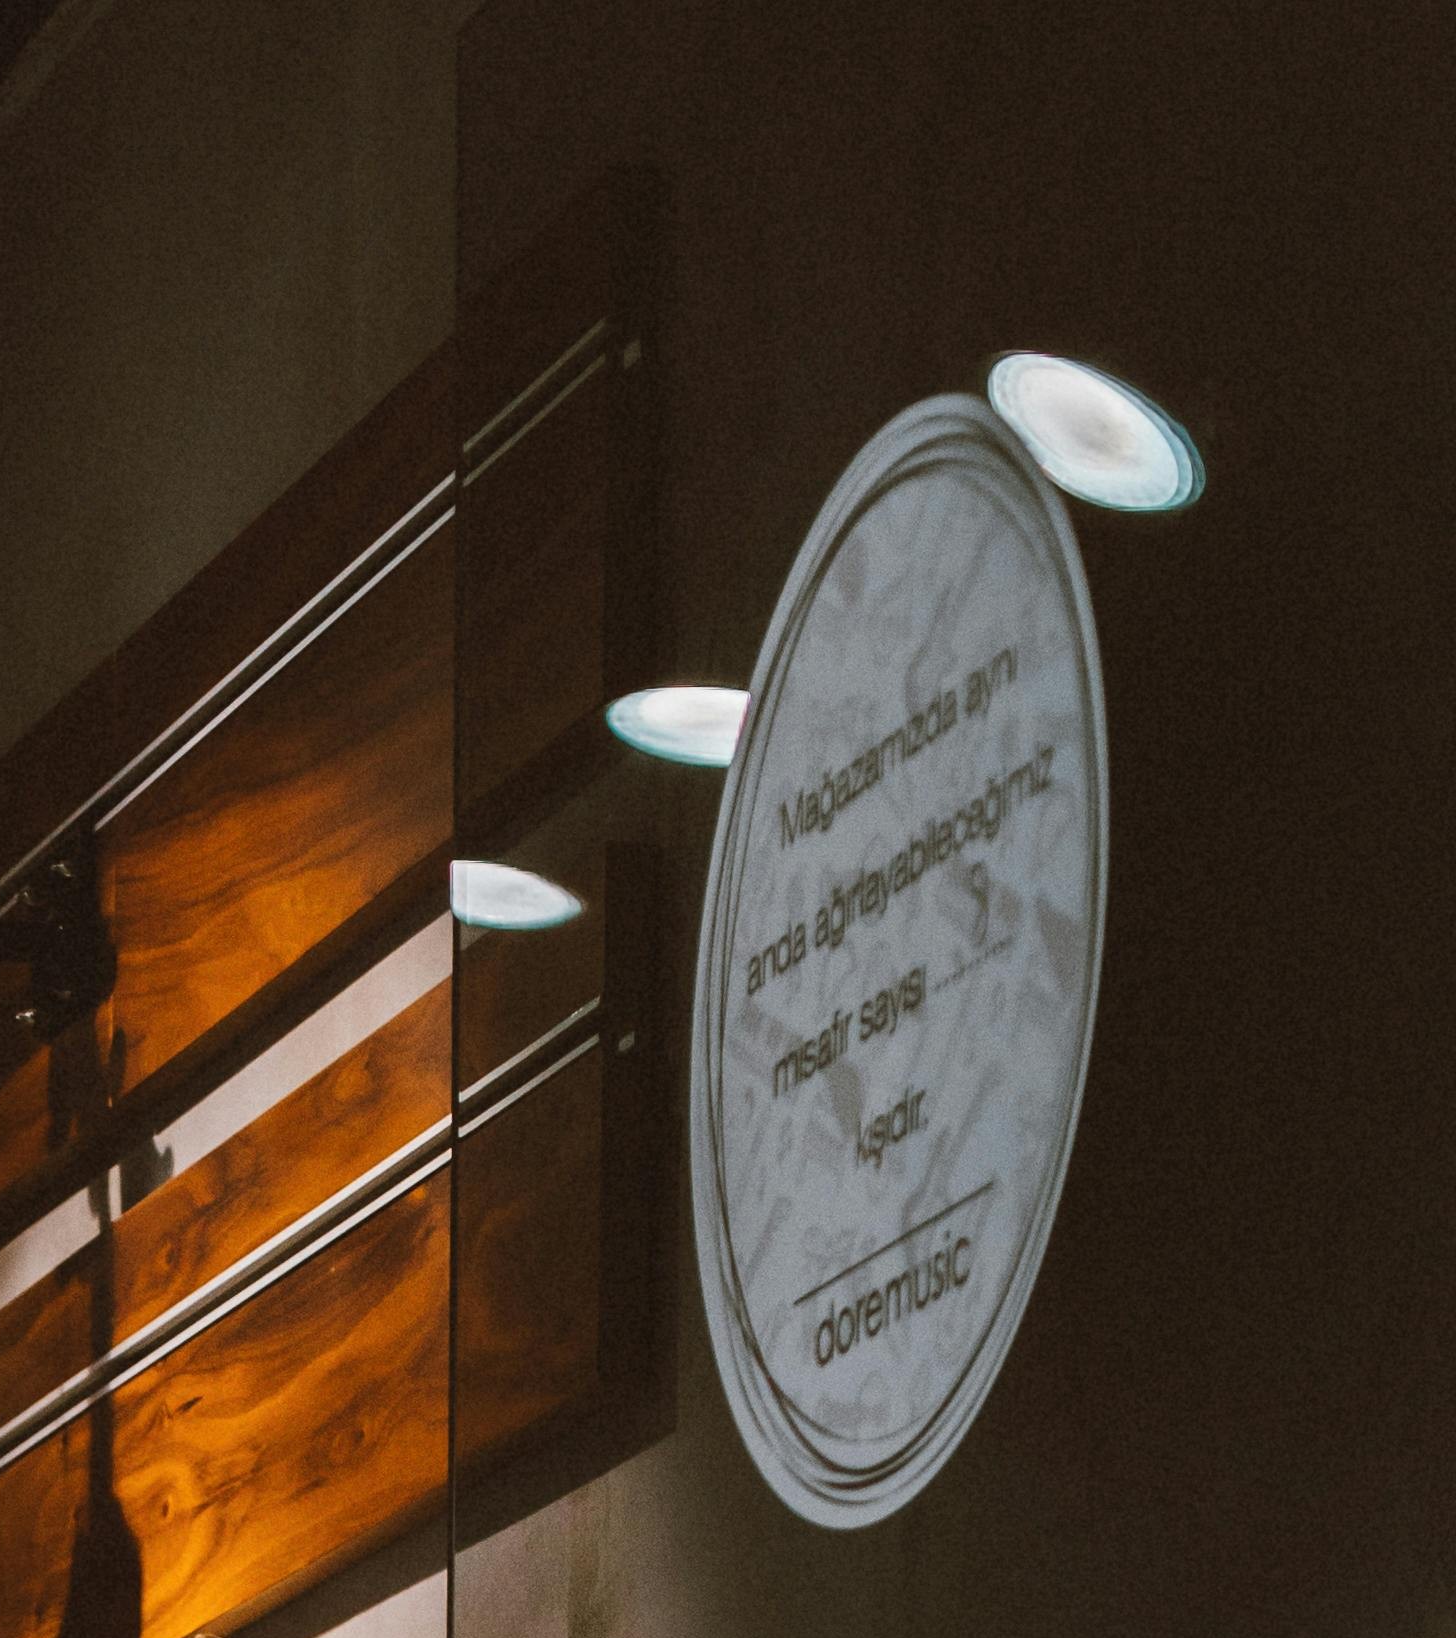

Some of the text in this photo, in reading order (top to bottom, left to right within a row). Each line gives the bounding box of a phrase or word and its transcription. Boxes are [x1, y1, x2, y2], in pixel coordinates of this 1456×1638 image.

[748, 921, 807, 997] anda
[772, 1009, 853, 1098] misafir
[815, 1229, 971, 1368] doremusic
